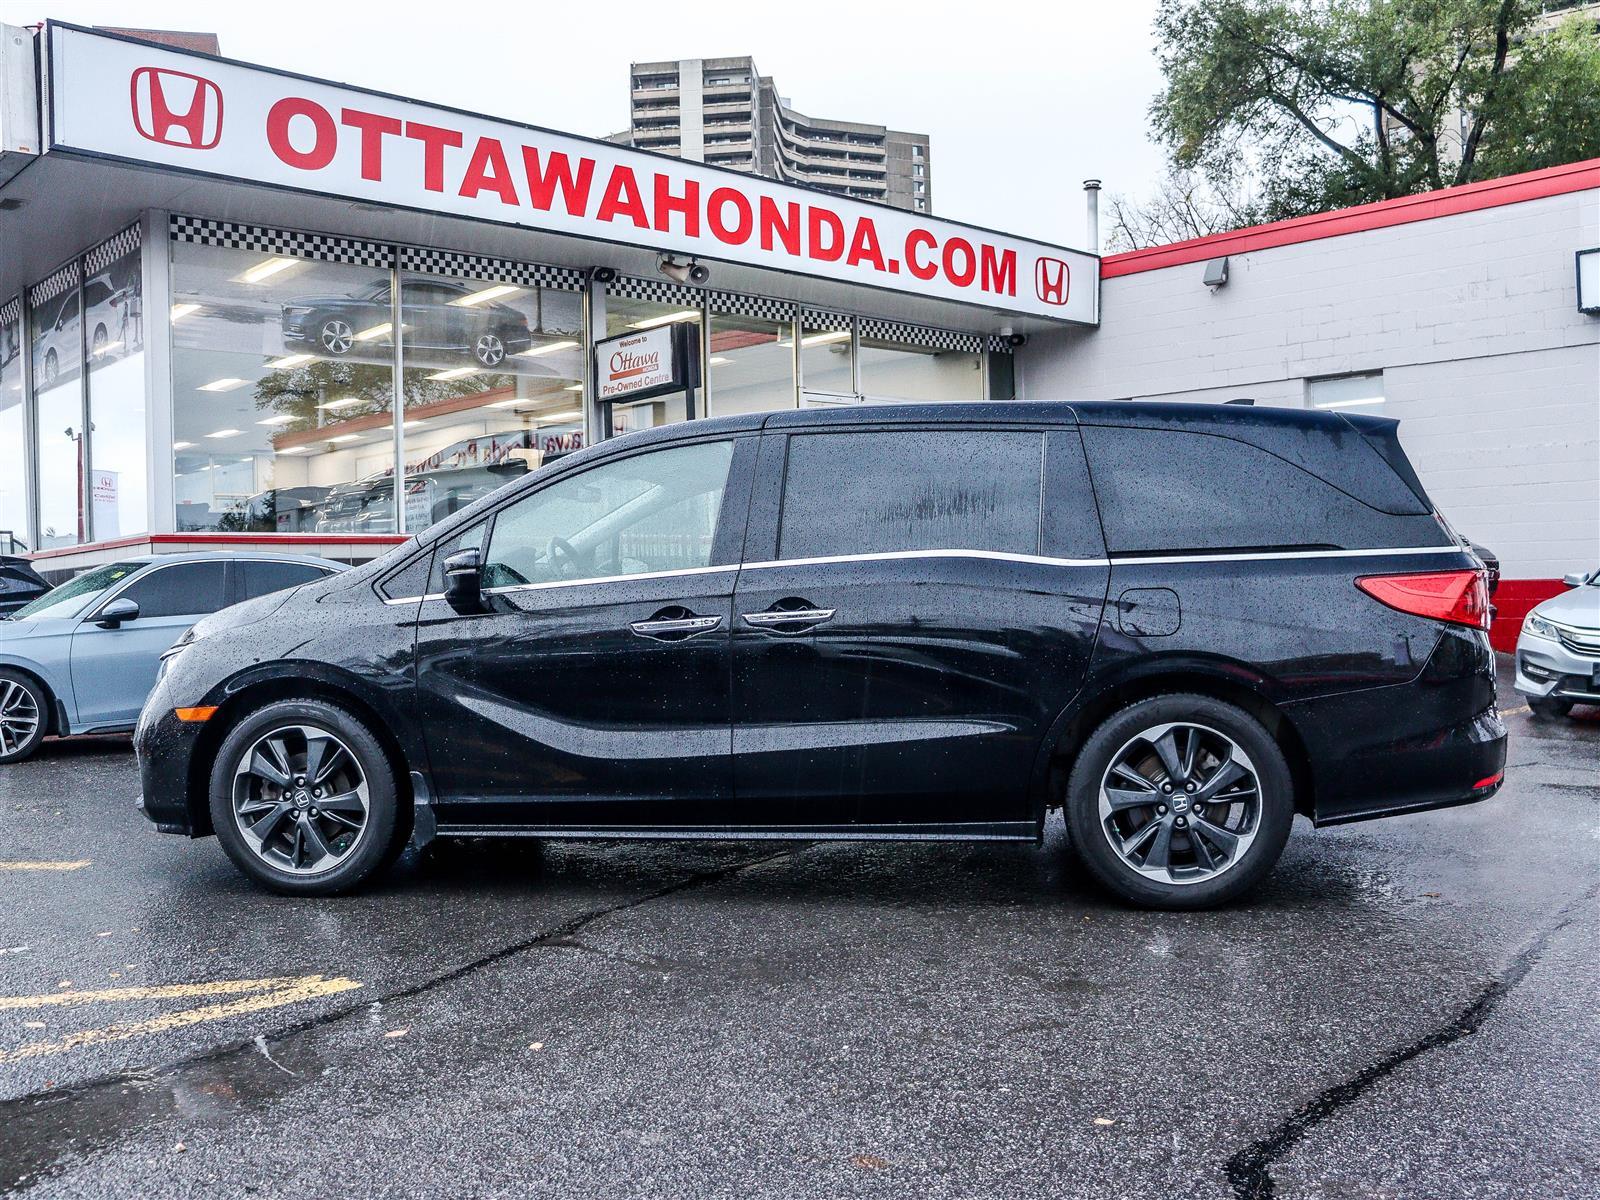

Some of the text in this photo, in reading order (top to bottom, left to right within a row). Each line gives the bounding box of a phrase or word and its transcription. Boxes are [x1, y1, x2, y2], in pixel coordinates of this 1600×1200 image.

[266, 97, 1017, 298] OTTAWAHONDA.COM
[619, 338, 641, 348] Welcome
[609, 351, 659, 373] Ottawa
[603, 374, 669, 395] Pre-Owned Centre
